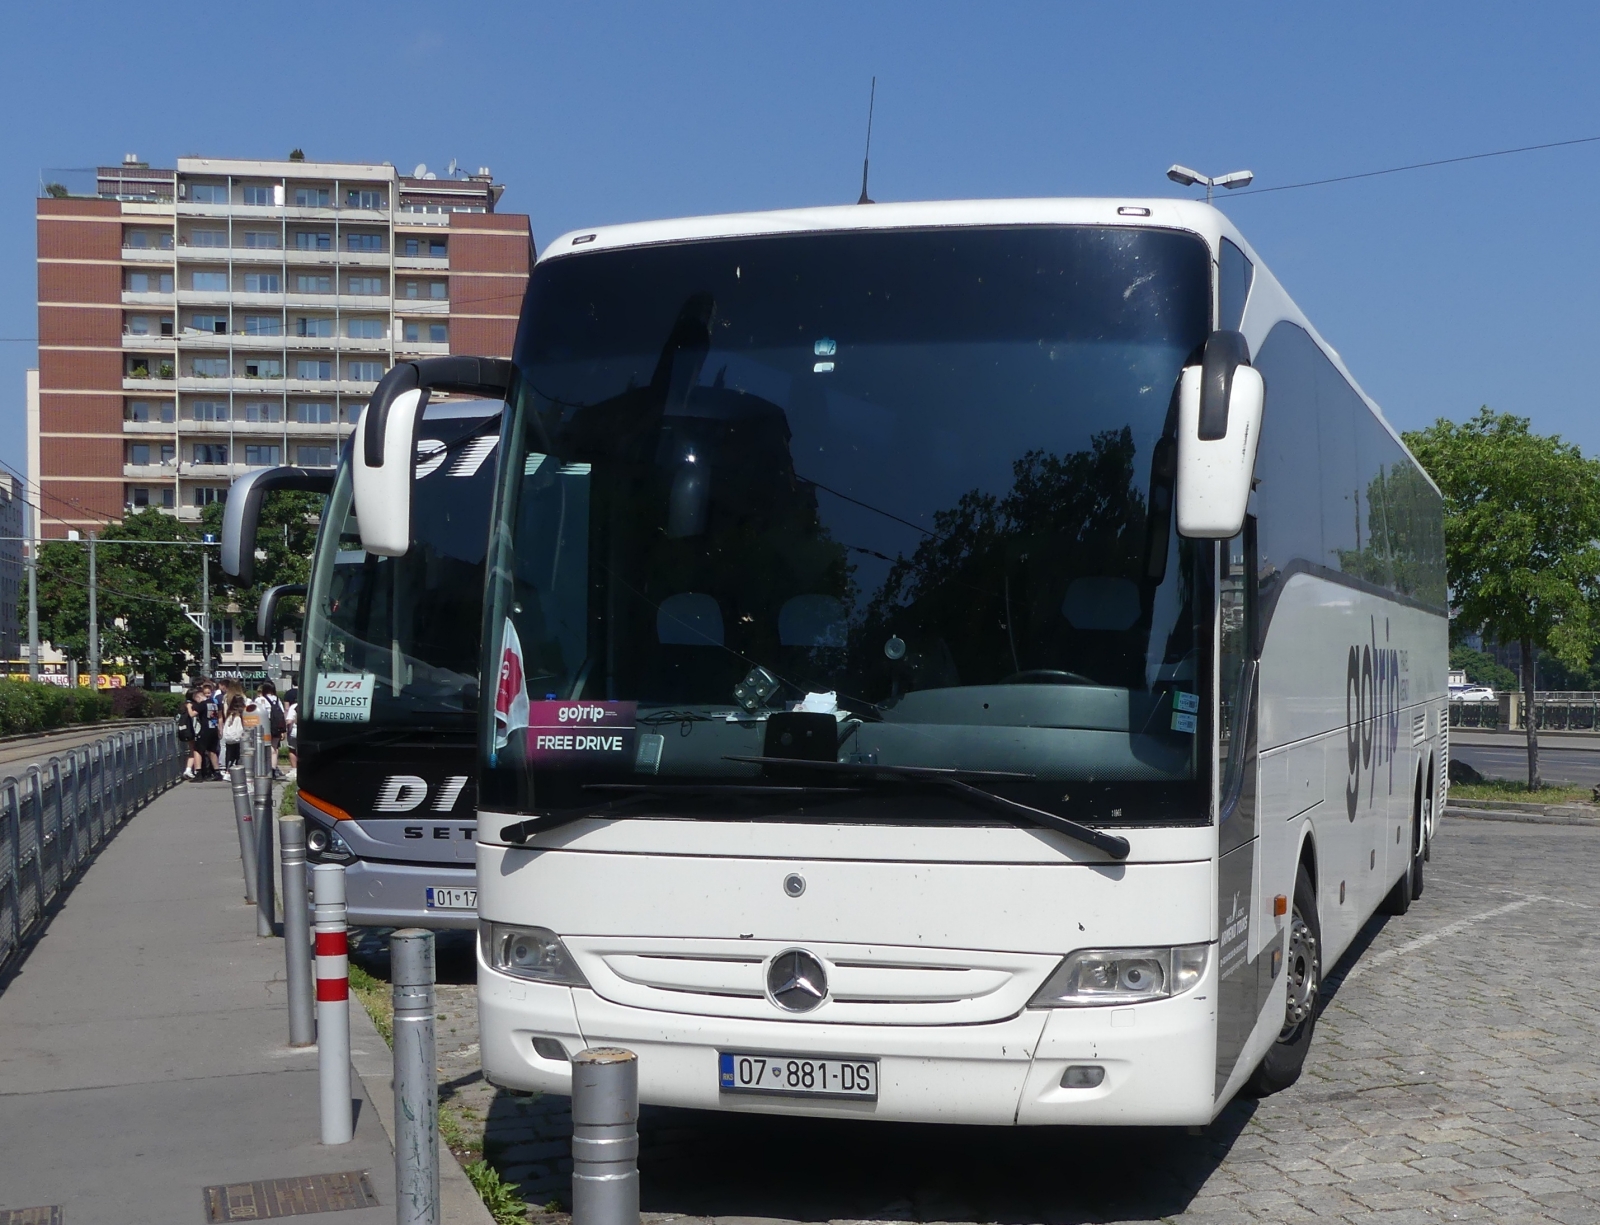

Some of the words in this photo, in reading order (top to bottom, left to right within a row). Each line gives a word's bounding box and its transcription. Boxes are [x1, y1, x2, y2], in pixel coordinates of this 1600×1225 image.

[326, 680, 362, 690] DITA
[317, 695, 368, 706] BUDAPEST
[320, 711, 339, 720] FREE
[340, 712, 364, 721] DRIVE
[536, 735, 573, 750] FREE
[575, 736, 623, 751] DRIVE
[372, 775, 469, 812] DI
